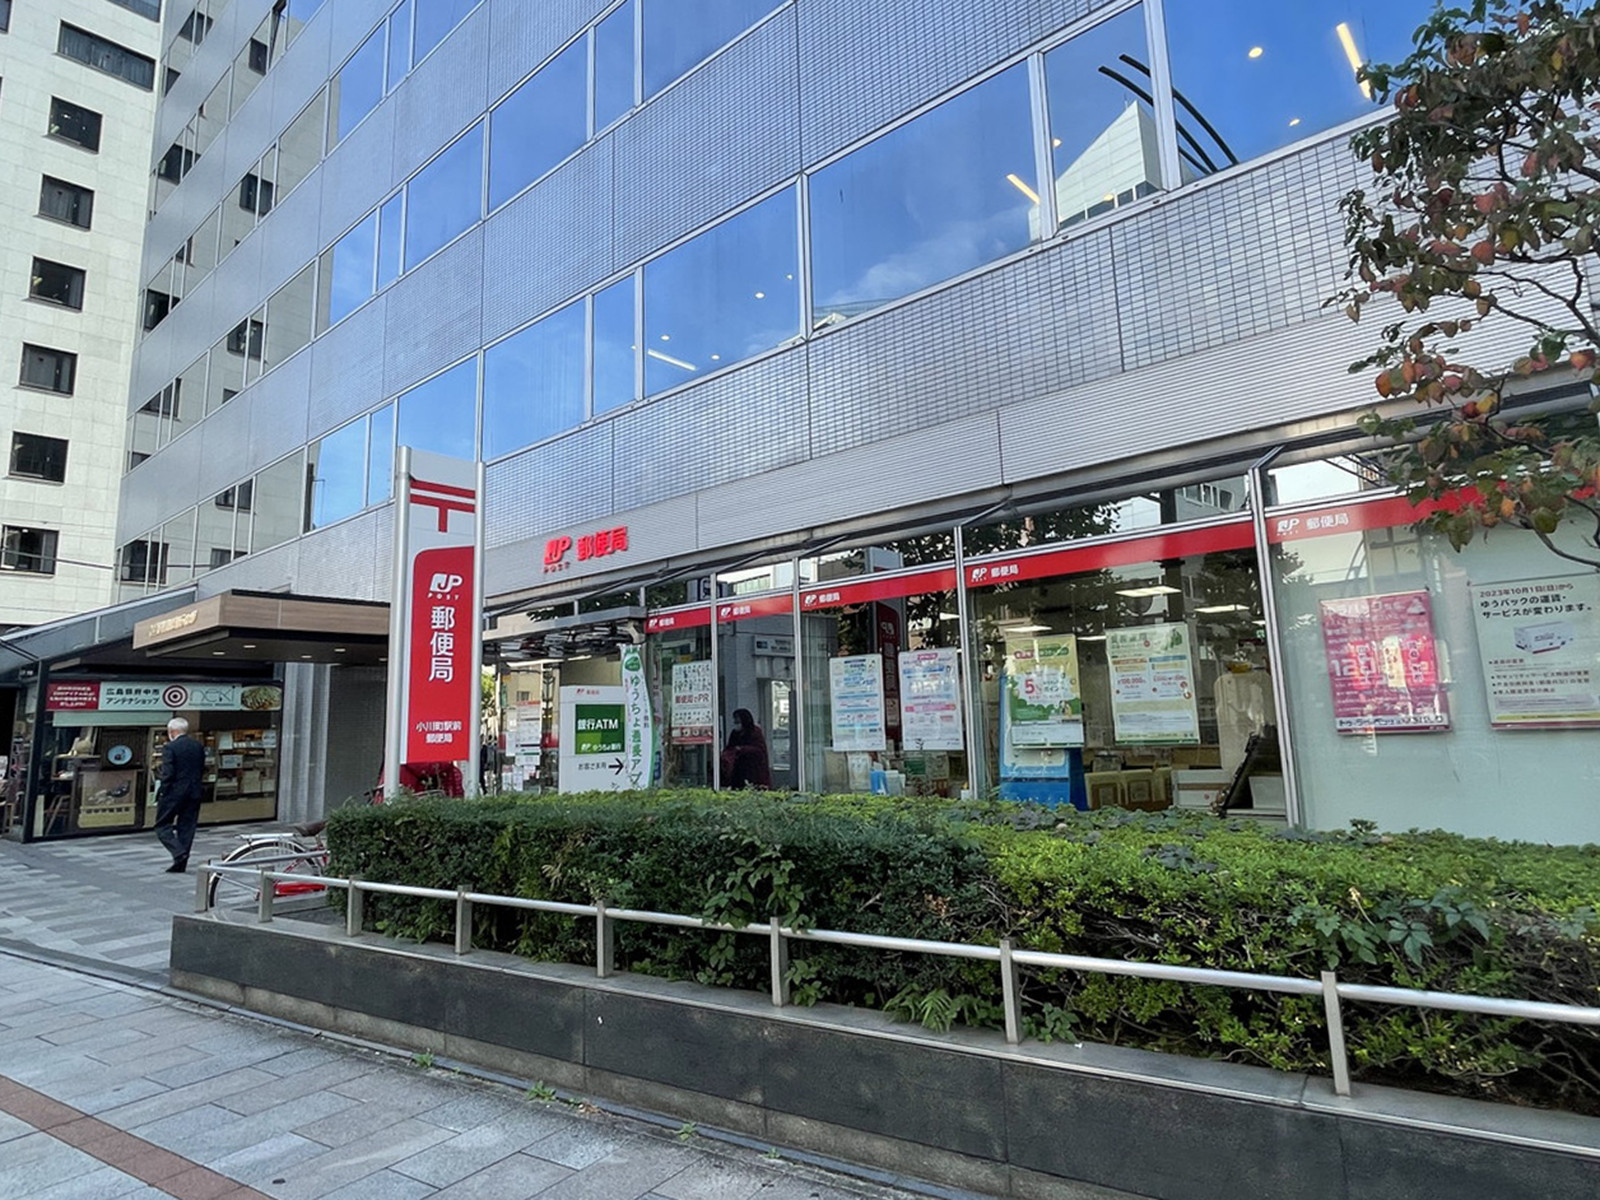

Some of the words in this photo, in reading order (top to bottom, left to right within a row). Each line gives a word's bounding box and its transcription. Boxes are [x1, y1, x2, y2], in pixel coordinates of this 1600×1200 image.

[1306, 513, 1349, 530] 郵便局
[577, 525, 629, 561] 郵便局
[427, 592, 460, 600] POST
[1482, 603, 1592, 619] サービスが変わります。
[428, 605, 455, 682] 郵便局
[106, 697, 160, 705] アンテナショップ
[416, 721, 462, 733] 小川町駅前
[577, 719, 619, 731] 銀行ATM
[425, 733, 453, 744] 郵便局
